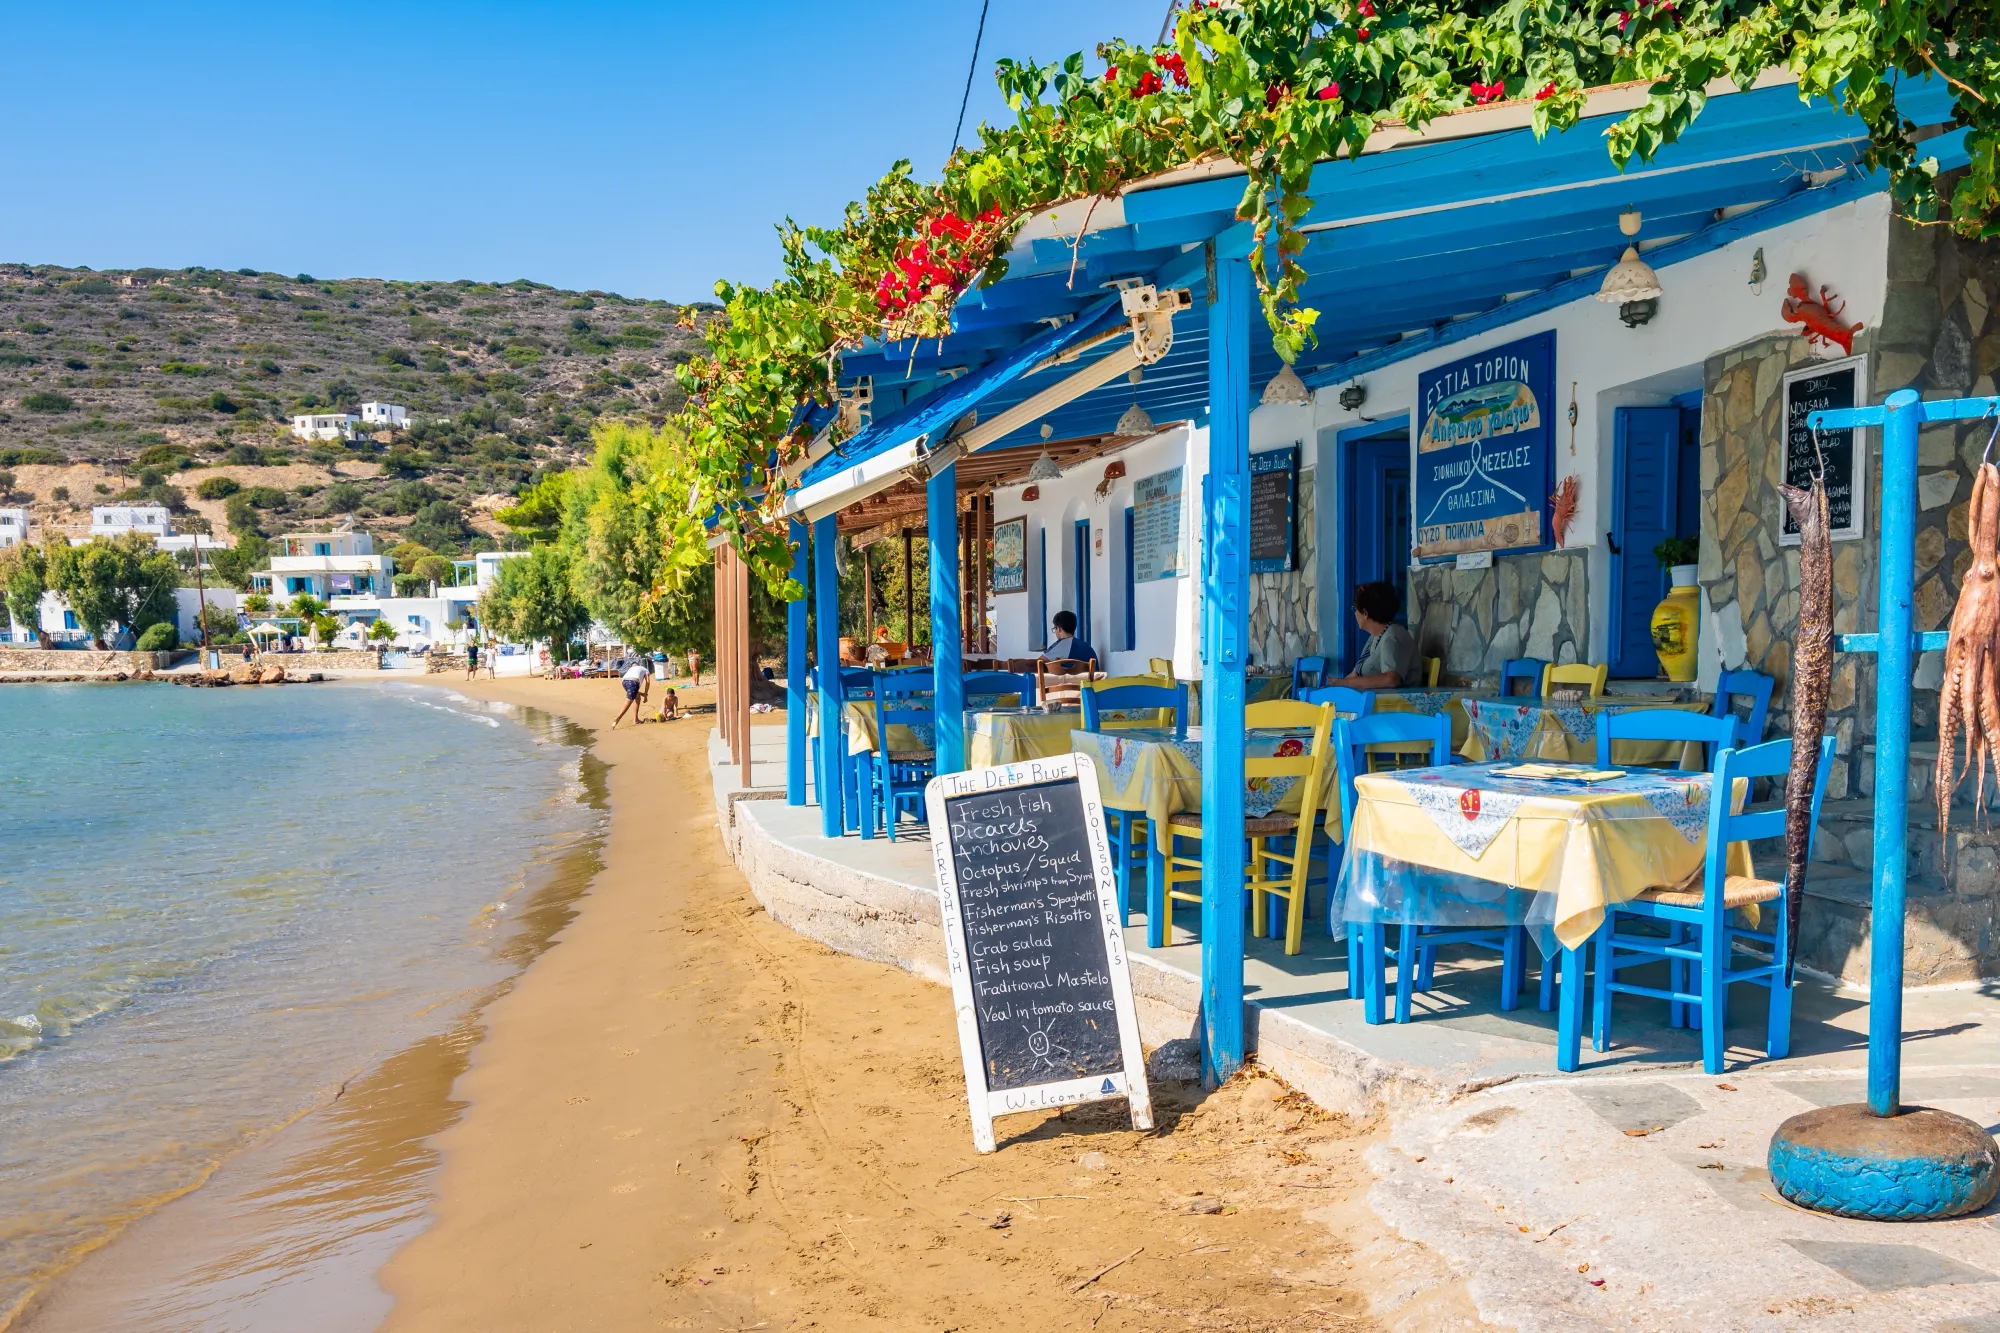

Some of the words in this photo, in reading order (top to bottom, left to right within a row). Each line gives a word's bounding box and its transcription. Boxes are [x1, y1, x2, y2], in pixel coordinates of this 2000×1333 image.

[1427, 356, 1529, 416] ΕΣΤΙΑΤΟΡΙΟΝ
[1805, 377, 1830, 392] DAILY
[1790, 397, 1829, 419] MOUSAKA
[1790, 431, 1808, 445] CRAB
[1790, 443, 1809, 458] CRAB
[1258, 456, 1271, 470] DEEP
[1482, 446, 1531, 472] ΜΕΖΕΔΕΣ
[1448, 488, 1496, 511] ΘΑΛΑΣΣΙΝΑ
[1418, 526, 1440, 545] ΟΥΖΟ
[1446, 521, 1485, 540] ΠΟΙΚΙΛΙΑ
[947, 775, 977, 794] THE
[985, 770, 1024, 788] DEEP
[1032, 763, 1068, 782] BLUE
[956, 799, 1012, 823] Fresh
[1018, 792, 1051, 815] fish
[951, 817, 1038, 842] Picarels
[955, 834, 1050, 862] Anchovies
[962, 862, 1021, 881] Octopus
[1038, 850, 1081, 874] Squid
[960, 878, 999, 899] Fresh
[1000, 876, 1048, 893] shrimps
[1050, 875, 1069, 887] from
[1088, 802, 1112, 890] POISSON
[1103, 899, 1121, 966] FRAIS
[935, 841, 954, 912] FRESH
[946, 917, 962, 974] FISH
[963, 898, 1045, 920] Fisherman's
[1047, 890, 1096, 908] Spaghetti
[966, 915, 1040, 937] Fisherman's
[1044, 909, 1092, 925] Risotto
[972, 941, 1009, 957] Crab
[1012, 932, 1053, 952] salad
[973, 957, 1010, 975] Fish
[1014, 953, 1051, 972] soup
[975, 973, 1053, 997] Traditional
[1057, 969, 1109, 988] Mastelo
[981, 1002, 1012, 1023] Veal
[1015, 1004, 1029, 1021] in
[1032, 999, 1074, 1017] tomato
[1077, 998, 1115, 1013] sauce
[1005, 1090, 1085, 1110] Welcome
